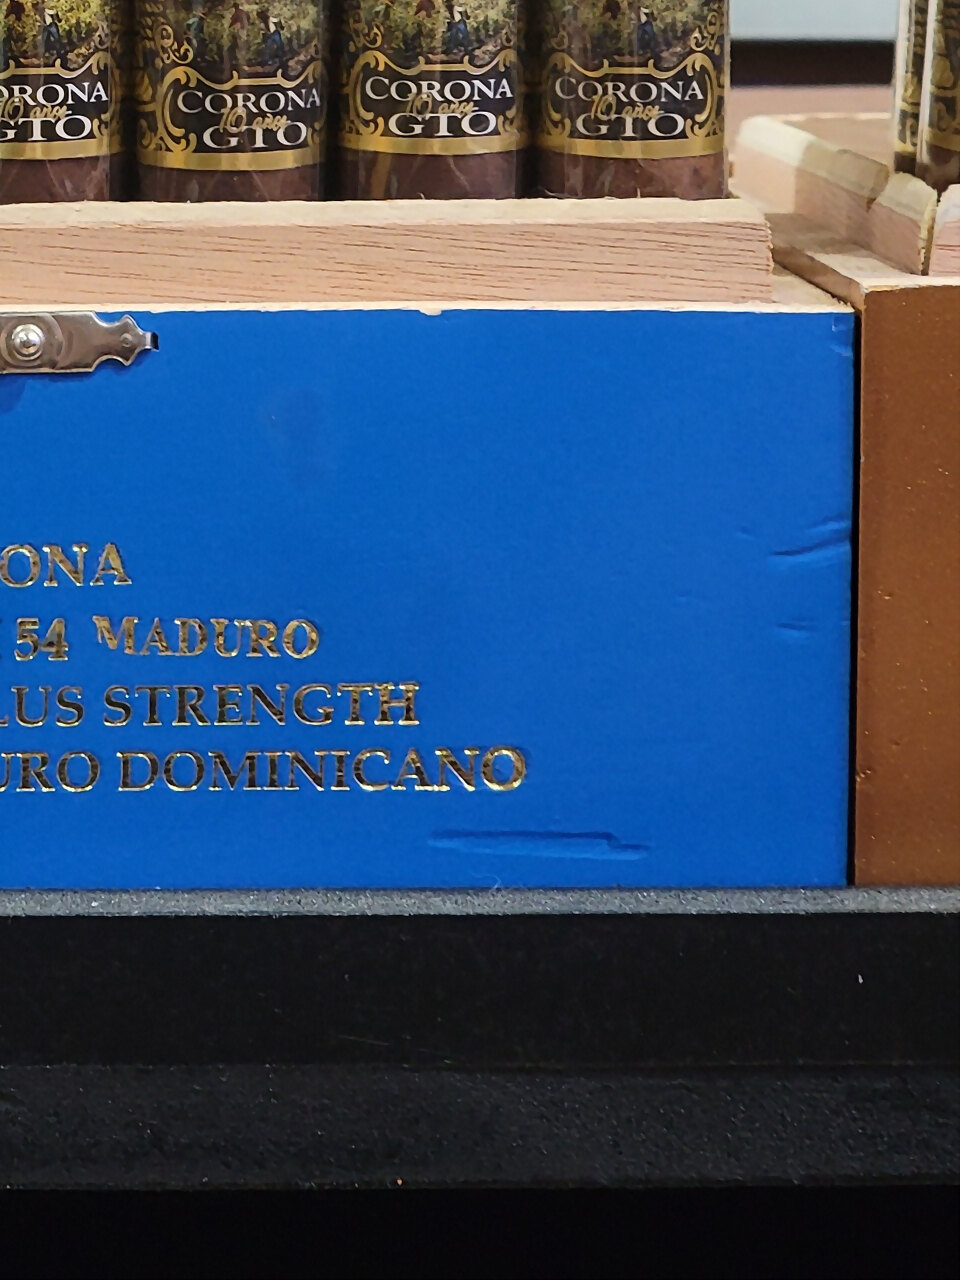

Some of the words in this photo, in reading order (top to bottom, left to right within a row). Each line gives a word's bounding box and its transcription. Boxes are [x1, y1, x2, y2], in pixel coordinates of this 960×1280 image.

[177, 88, 321, 113] CORONA
[365, 76, 514, 102] CORONA
[555, 76, 704, 103] CORONA
[203, 121, 307, 148] GTO
[389, 111, 497, 136] GTO
[576, 112, 685, 137] GTO
[14, 618, 70, 662] 54
[92, 615, 320, 660] MADURO
[103, 681, 420, 728] STRENGTH
[116, 746, 527, 793] DOMINICANO
